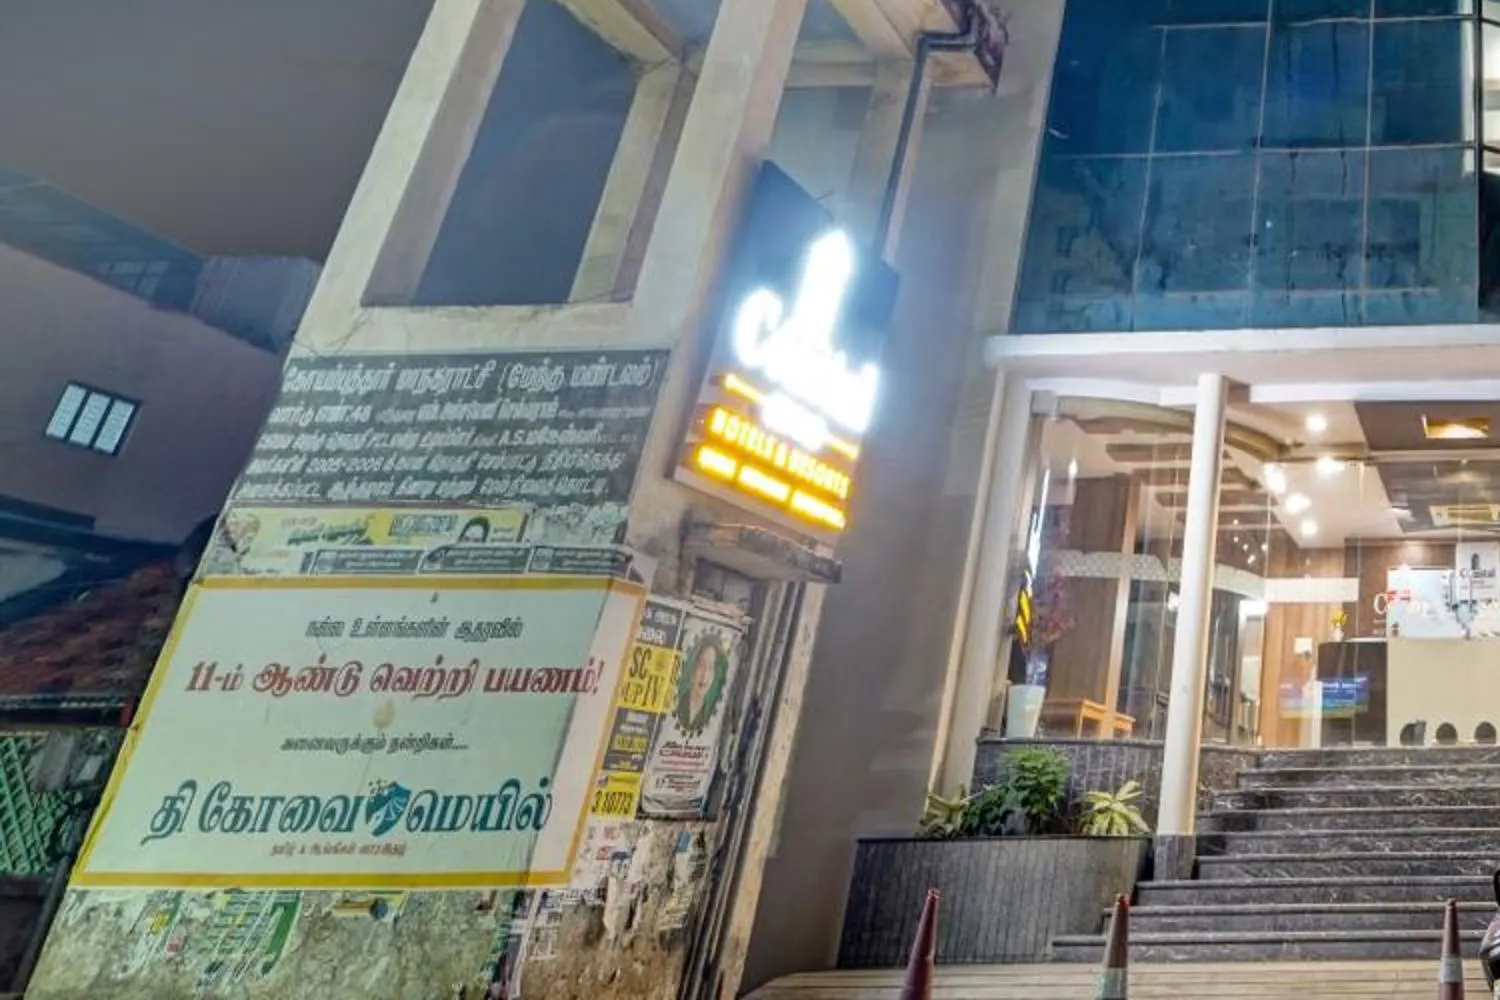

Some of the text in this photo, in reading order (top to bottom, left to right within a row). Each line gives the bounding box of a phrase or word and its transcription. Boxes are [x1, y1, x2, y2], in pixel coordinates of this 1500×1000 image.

[394, 359, 496, 395] மாநகராட்சி
[252, 654, 364, 697] ஆண்டு
[369, 655, 480, 699] வெற்றி
[483, 655, 606, 697] பயணம்!
[140, 776, 554, 846] தி கோவை மெயில்
